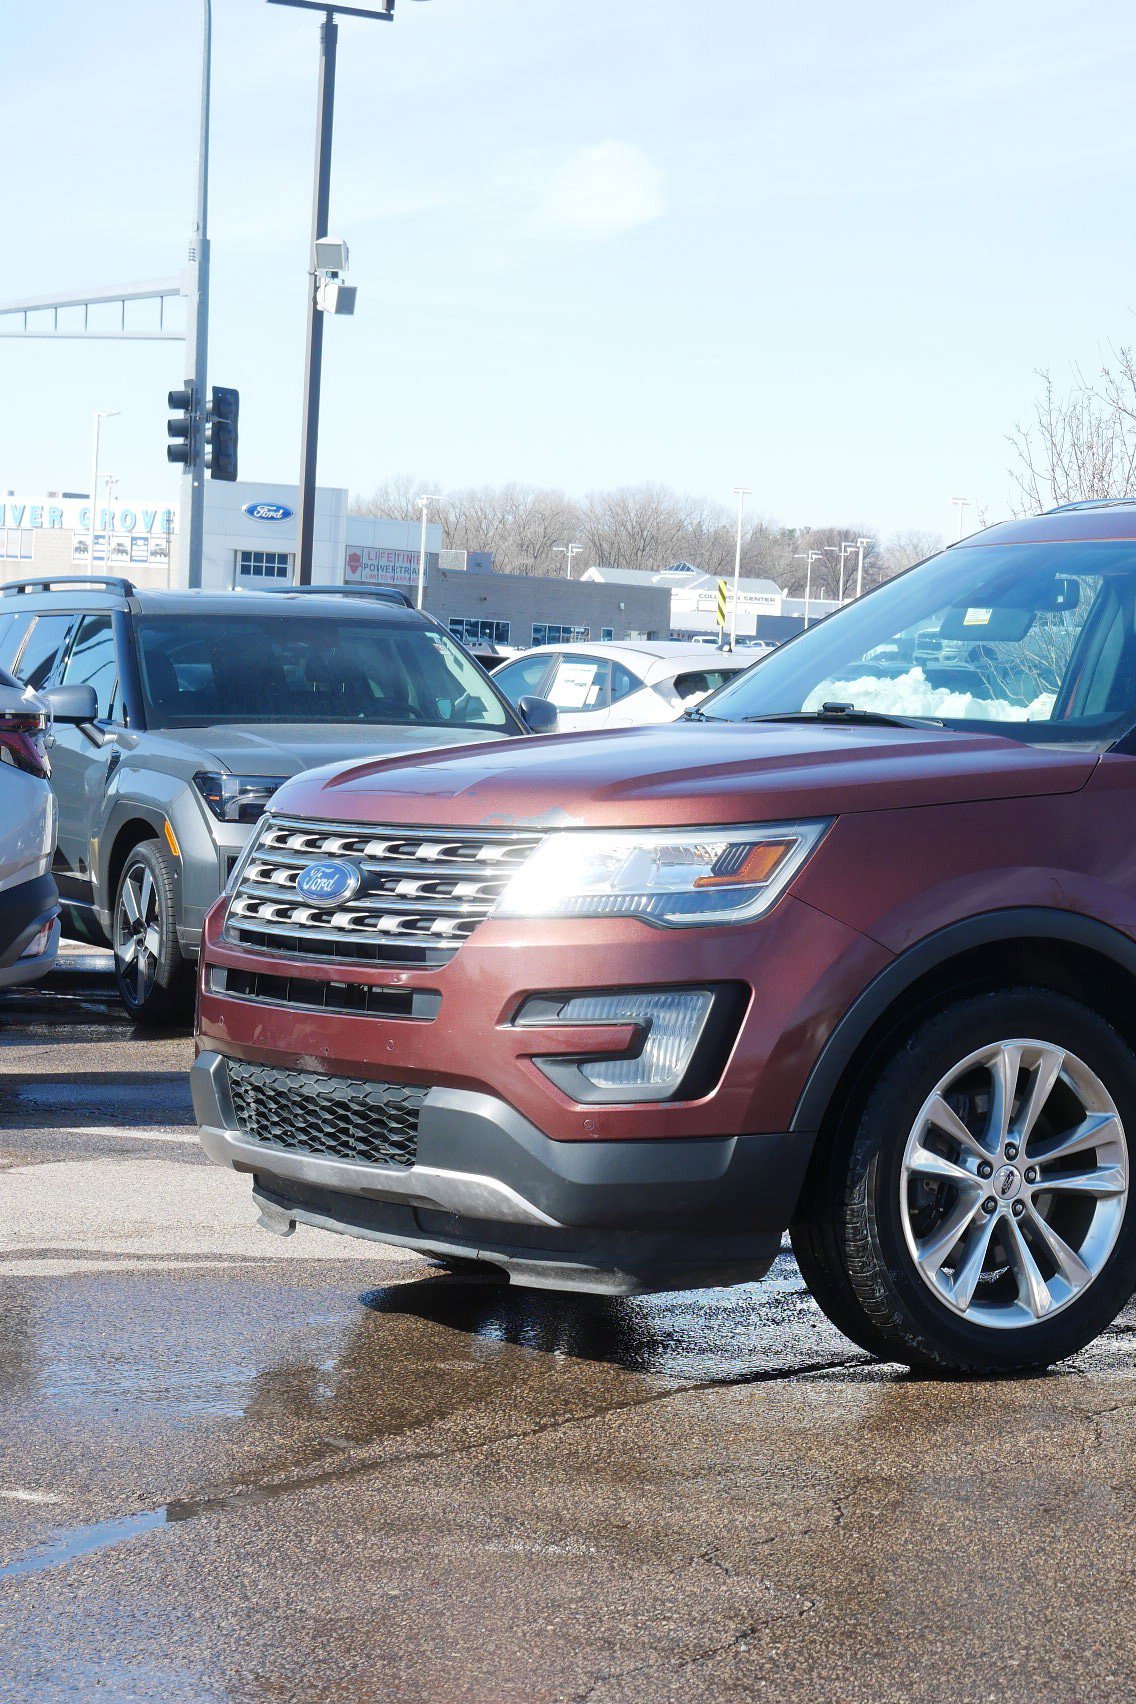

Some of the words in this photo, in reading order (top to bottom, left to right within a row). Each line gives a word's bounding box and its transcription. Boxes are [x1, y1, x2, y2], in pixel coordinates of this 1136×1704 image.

[78, 506, 175, 533] GROVE
[367, 551, 421, 565] LIFETIME
[363, 563, 426, 576] POWERTRAI
[303, 866, 340, 892] Ford
